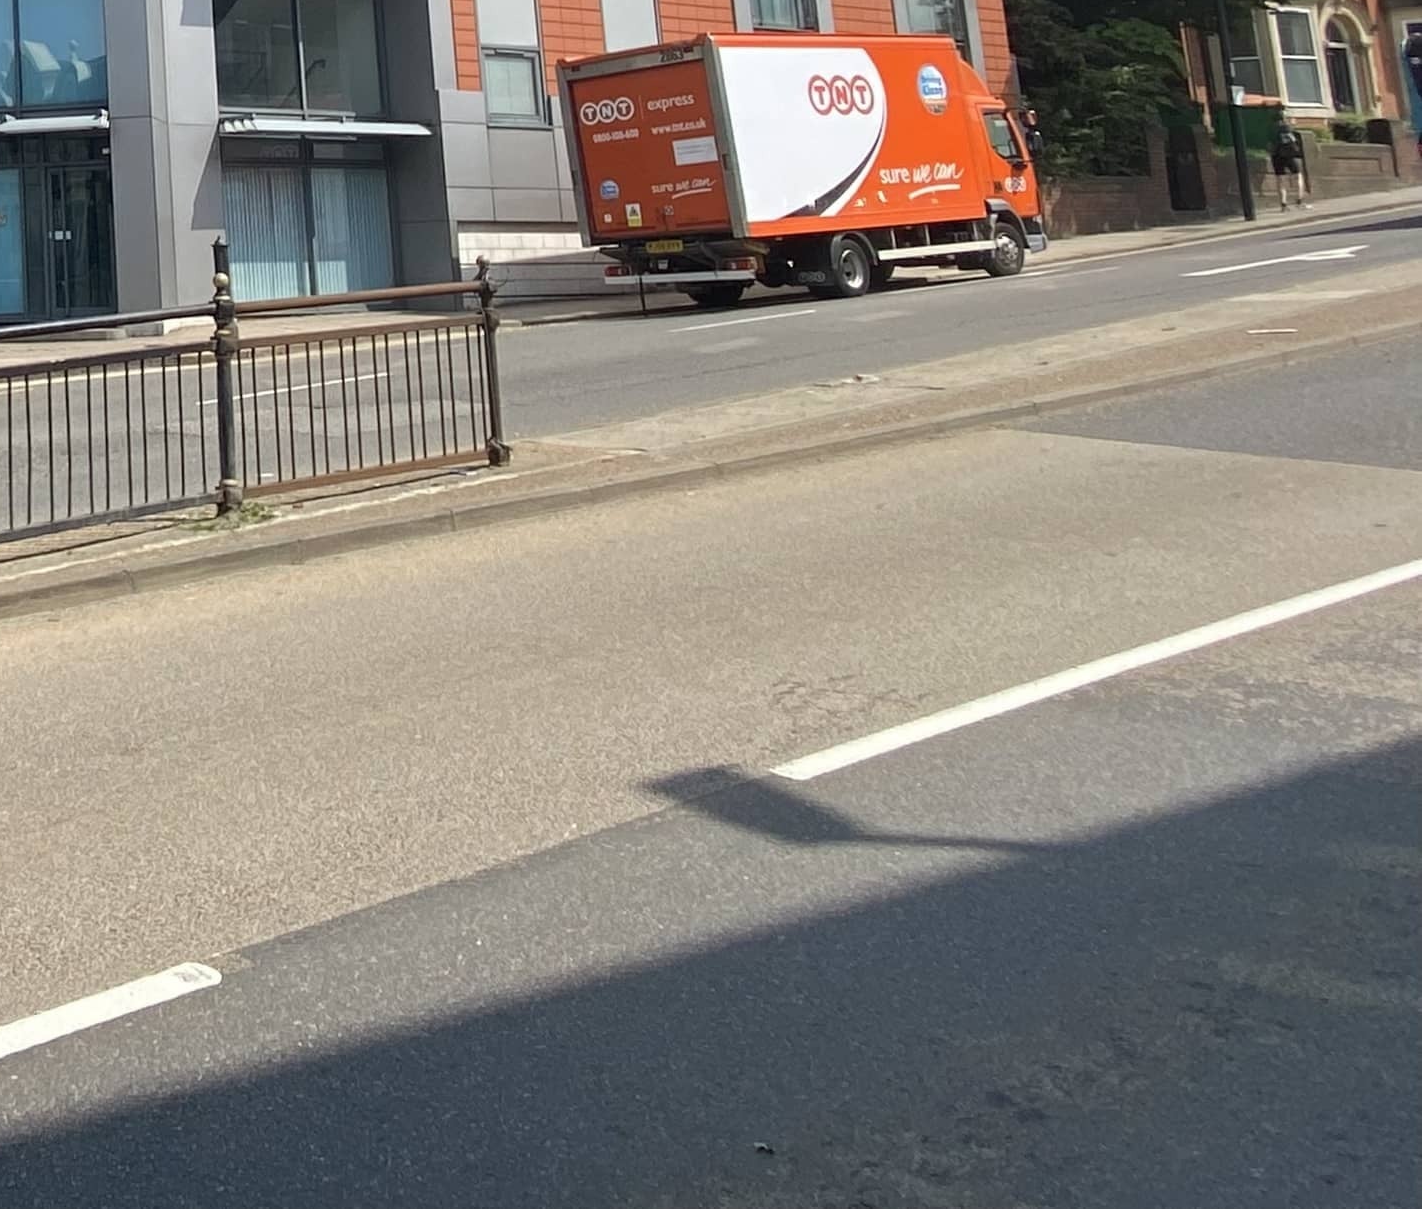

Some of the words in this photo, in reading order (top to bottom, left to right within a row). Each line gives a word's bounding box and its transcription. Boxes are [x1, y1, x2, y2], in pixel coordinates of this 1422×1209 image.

[811, 79, 871, 110] TNT
[582, 99, 633, 123] TNT
[647, 94, 695, 112] express
[651, 182, 674, 193] sure
[691, 177, 717, 188] can
[879, 168, 911, 184] sure
[912, 164, 932, 183] we
[933, 162, 965, 180] can
